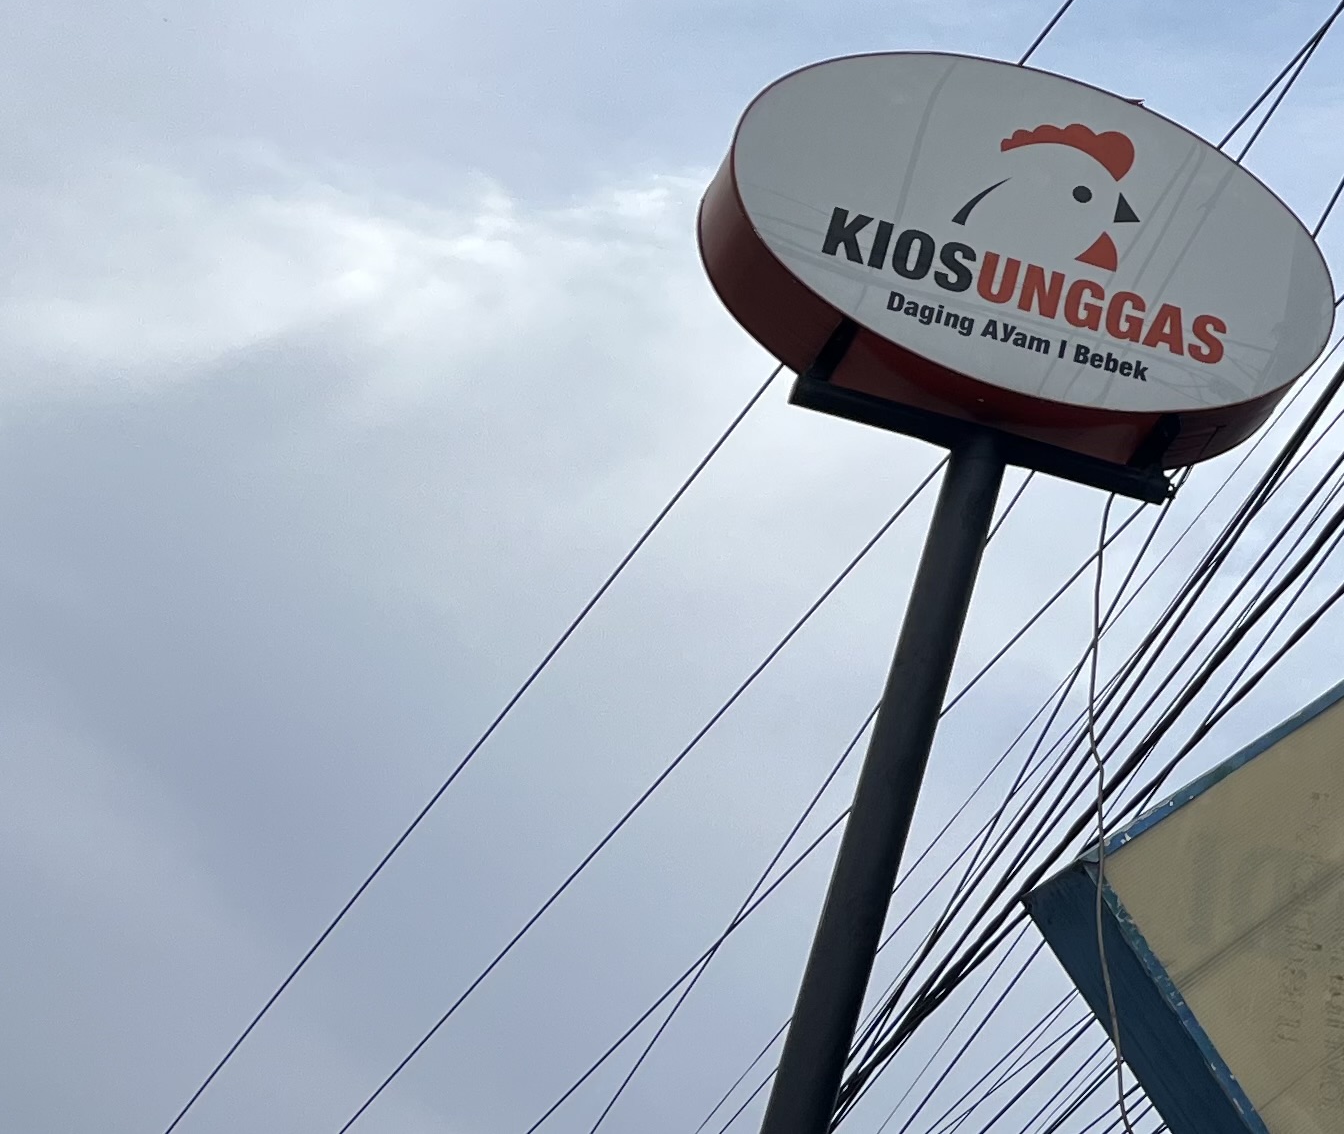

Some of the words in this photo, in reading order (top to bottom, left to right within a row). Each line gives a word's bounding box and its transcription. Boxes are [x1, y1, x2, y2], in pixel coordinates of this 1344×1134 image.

[822, 207, 1227, 364] KIOSUNGGAS
[886, 290, 975, 337] Daging
[1073, 343, 1149, 382] Bebek
